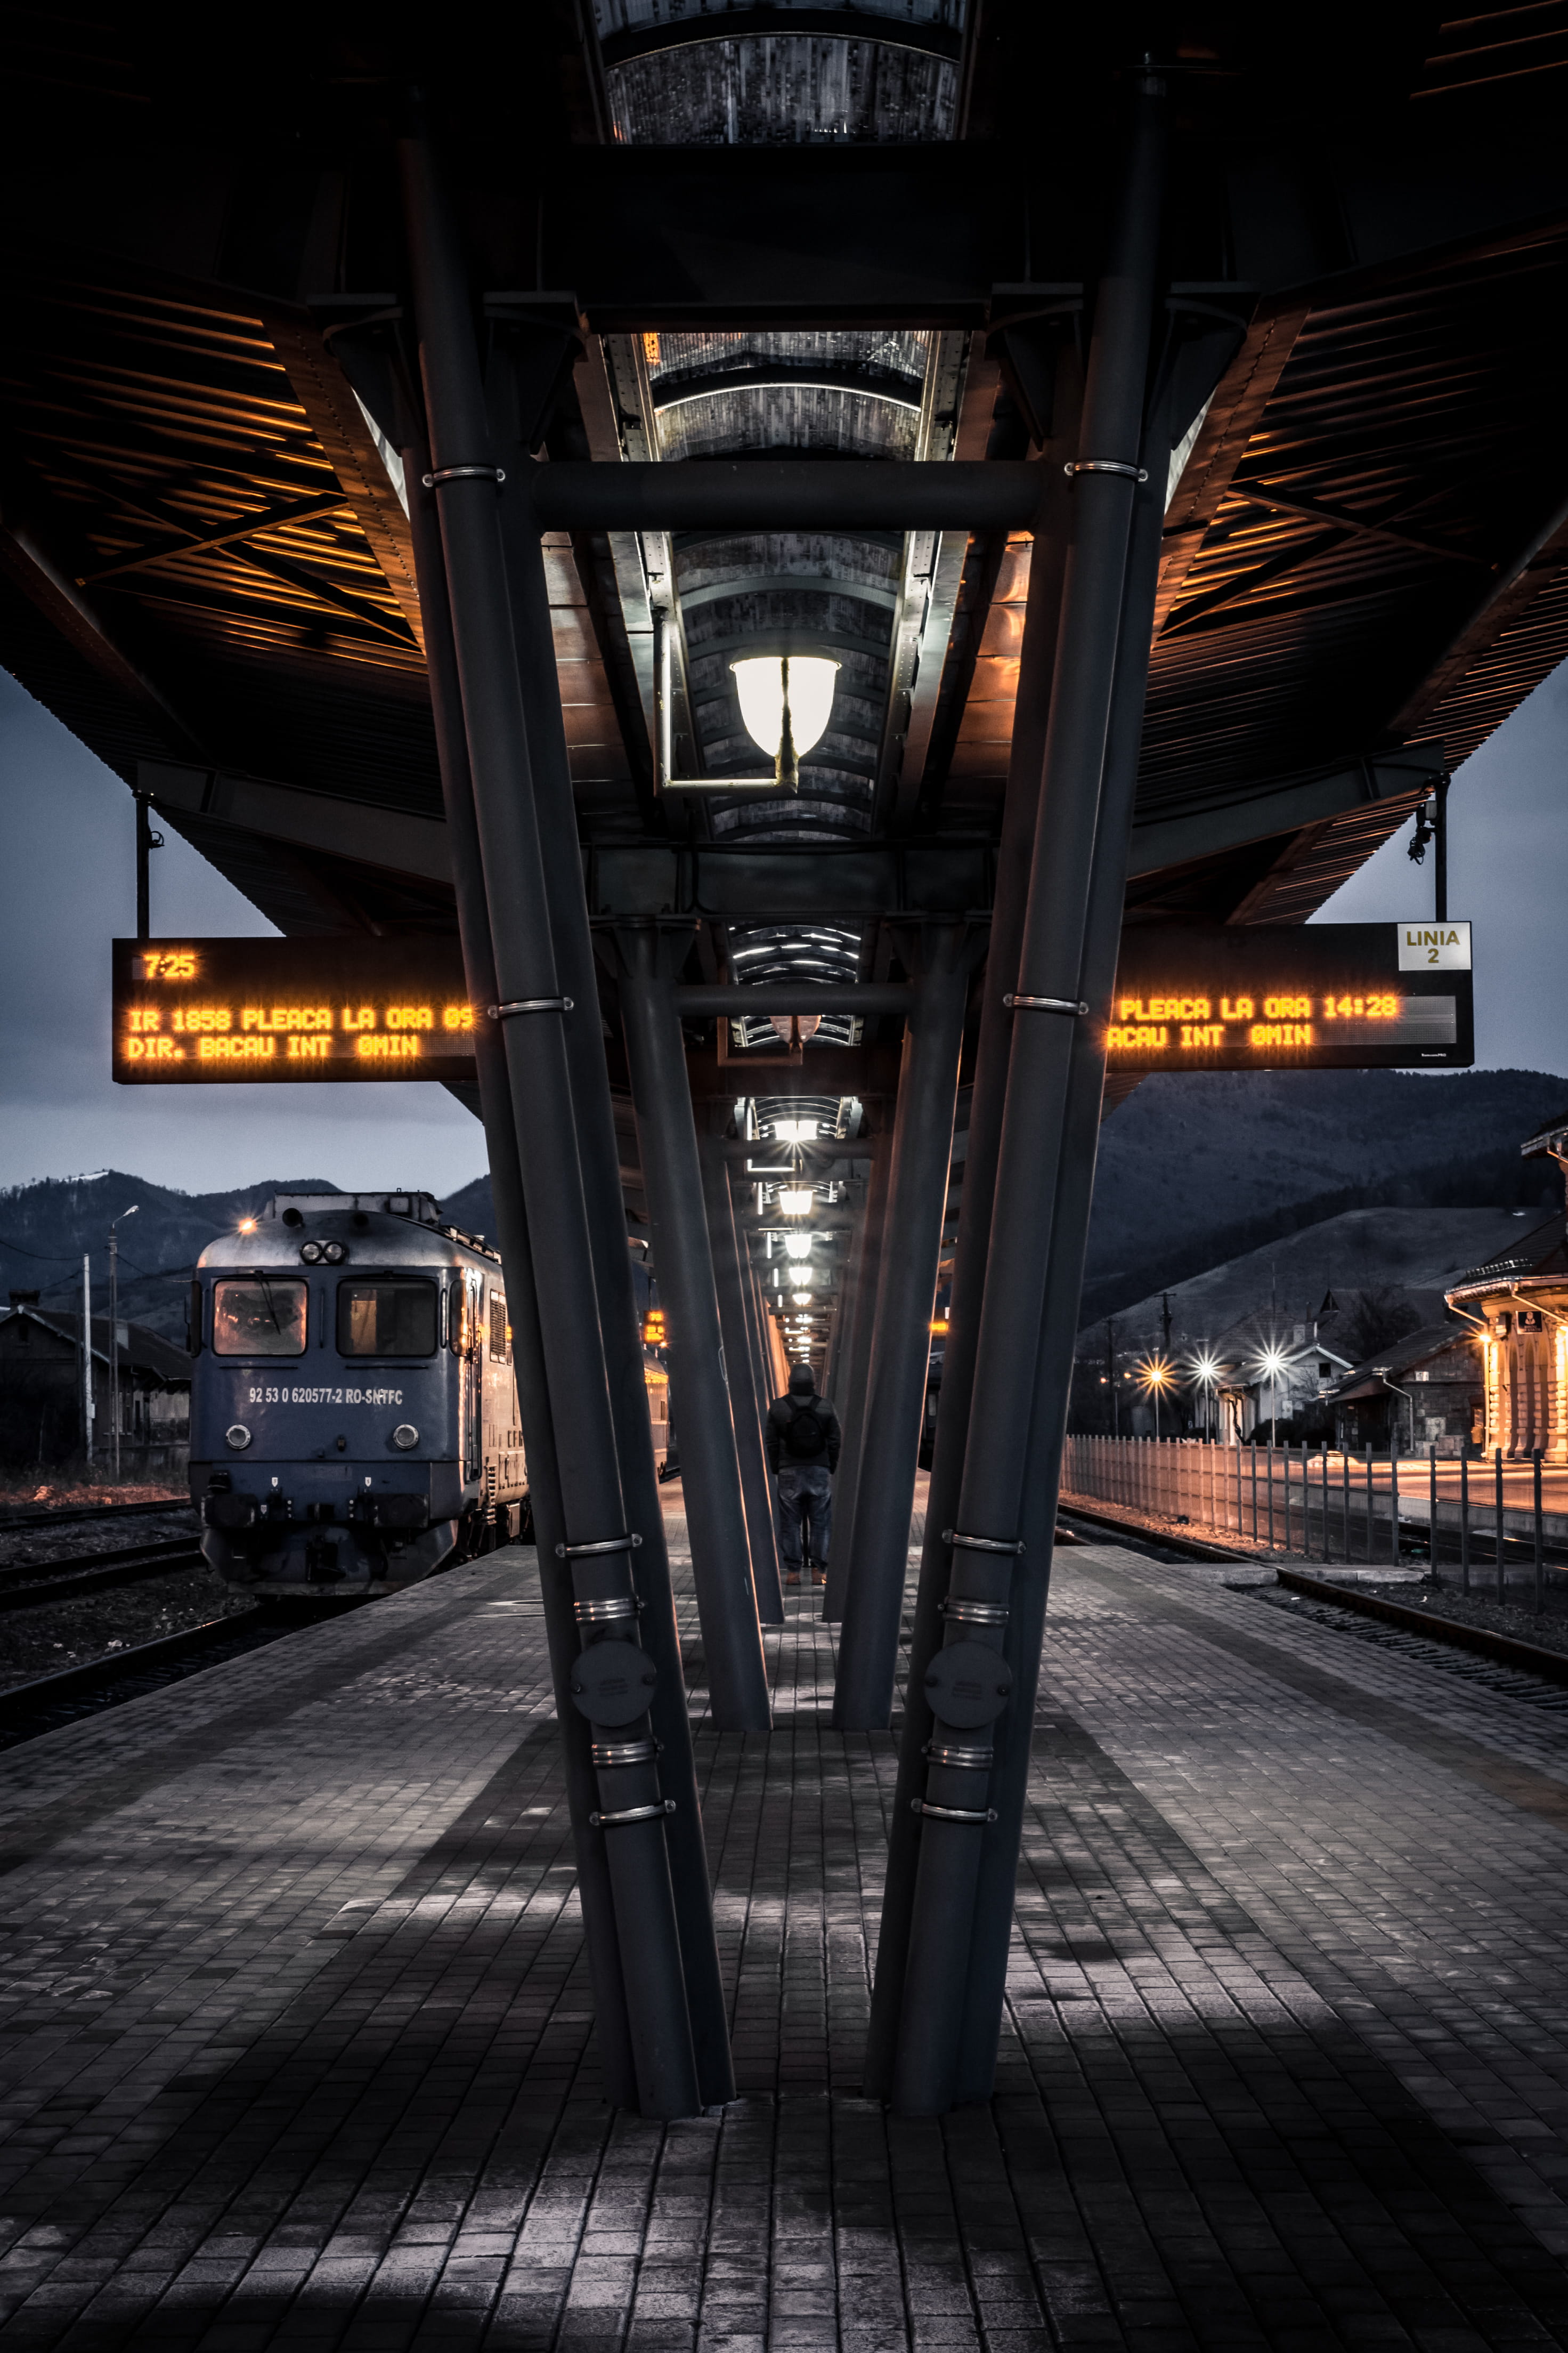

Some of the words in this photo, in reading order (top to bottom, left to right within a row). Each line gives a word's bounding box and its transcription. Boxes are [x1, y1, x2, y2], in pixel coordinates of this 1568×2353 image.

[1407, 931, 1460, 946] LINIA
[145, 955, 194, 978] 7:25
[1428, 948, 1439, 963] 2
[1120, 998, 1209, 1020] PLEACA
[1221, 998, 1253, 1019] LA
[1265, 997, 1311, 1018] ORA
[1325, 996, 1398, 1018] 14:28
[131, 1010, 160, 1032] IR
[173, 1010, 231, 1031] 1858
[242, 1008, 331, 1030] PLEACA
[343, 1008, 375, 1030] LA
[386, 1008, 432, 1029] ORA
[128, 1037, 183, 1058] DIR.
[199, 1036, 274, 1058] BACAU
[288, 1036, 331, 1057] INT
[1181, 1025, 1224, 1047] INT
[249, 1387, 262, 1403] 92
[266, 1388, 279, 1403] 53
[282, 1388, 288, 1403] 0
[291, 1388, 342, 1403] 620577-2
[346, 1389, 403, 1405] RO-SNTFC
